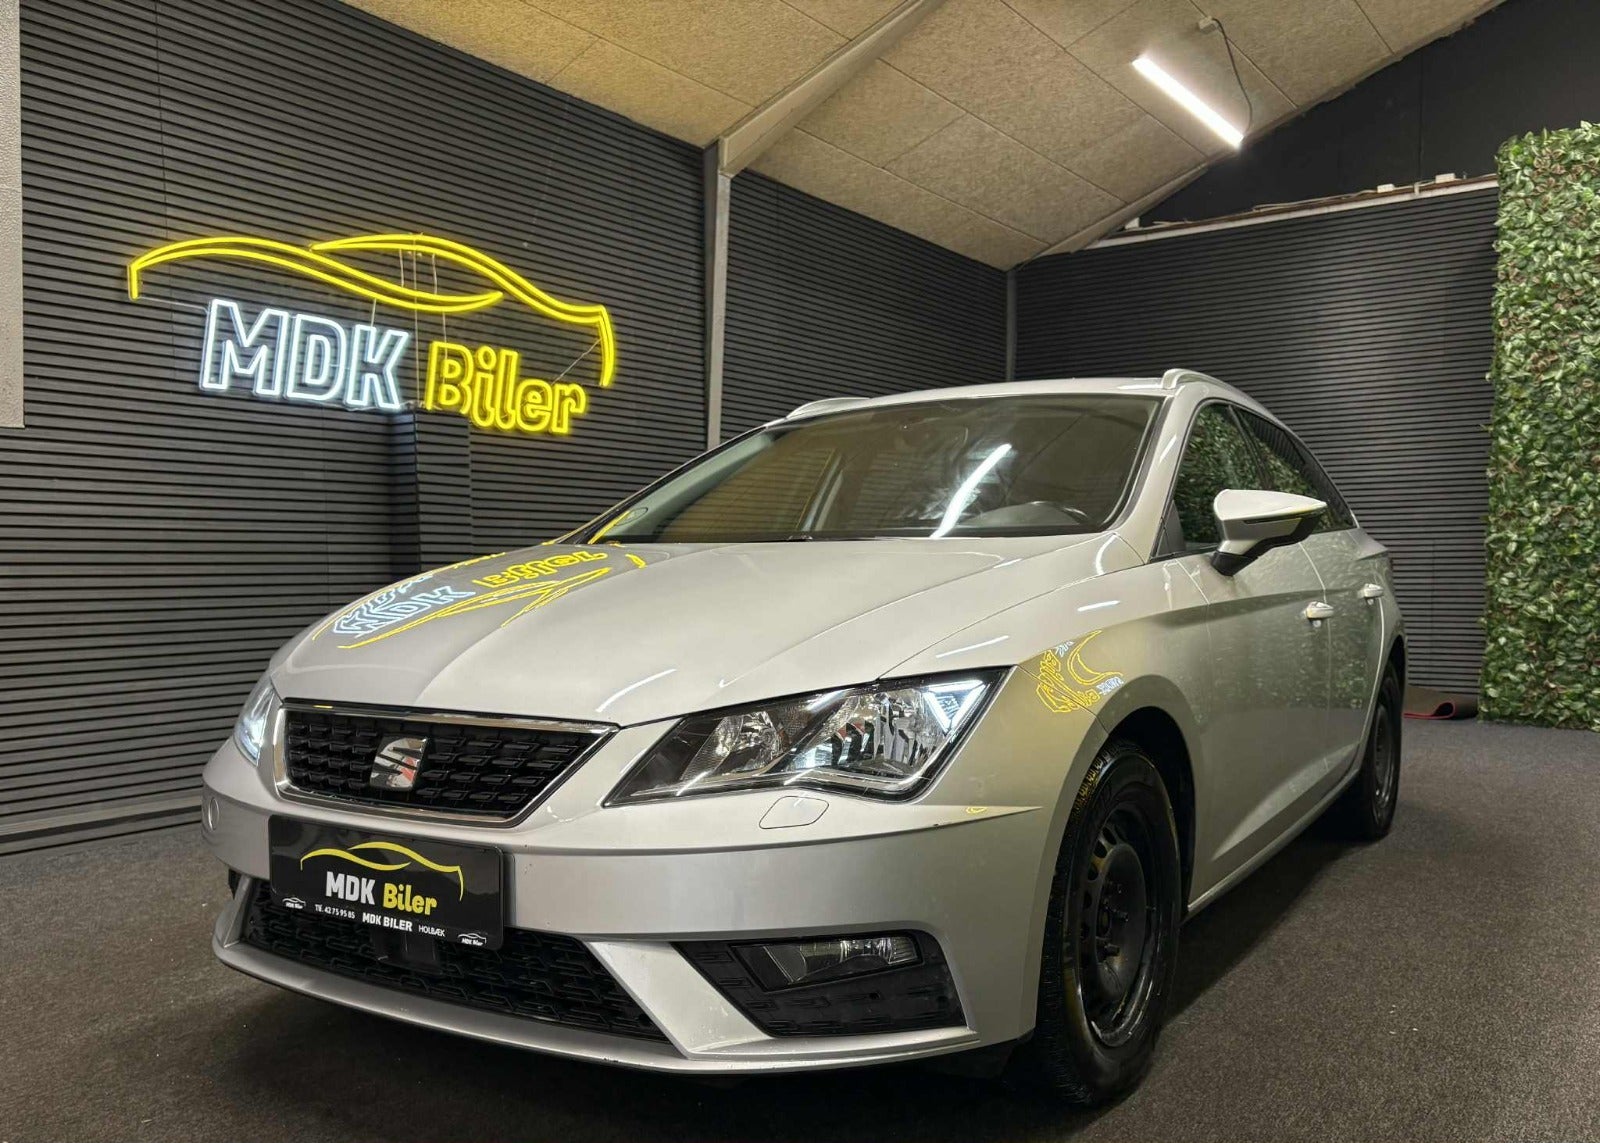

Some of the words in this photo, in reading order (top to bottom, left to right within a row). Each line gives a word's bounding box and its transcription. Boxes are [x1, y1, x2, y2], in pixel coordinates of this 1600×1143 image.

[199, 298, 410, 410] MDK
[424, 341, 587, 434] Biler
[325, 871, 376, 906] MDK
[383, 883, 438, 916] Biler
[362, 912, 381, 925] MDK
[383, 916, 413, 932] BILER
